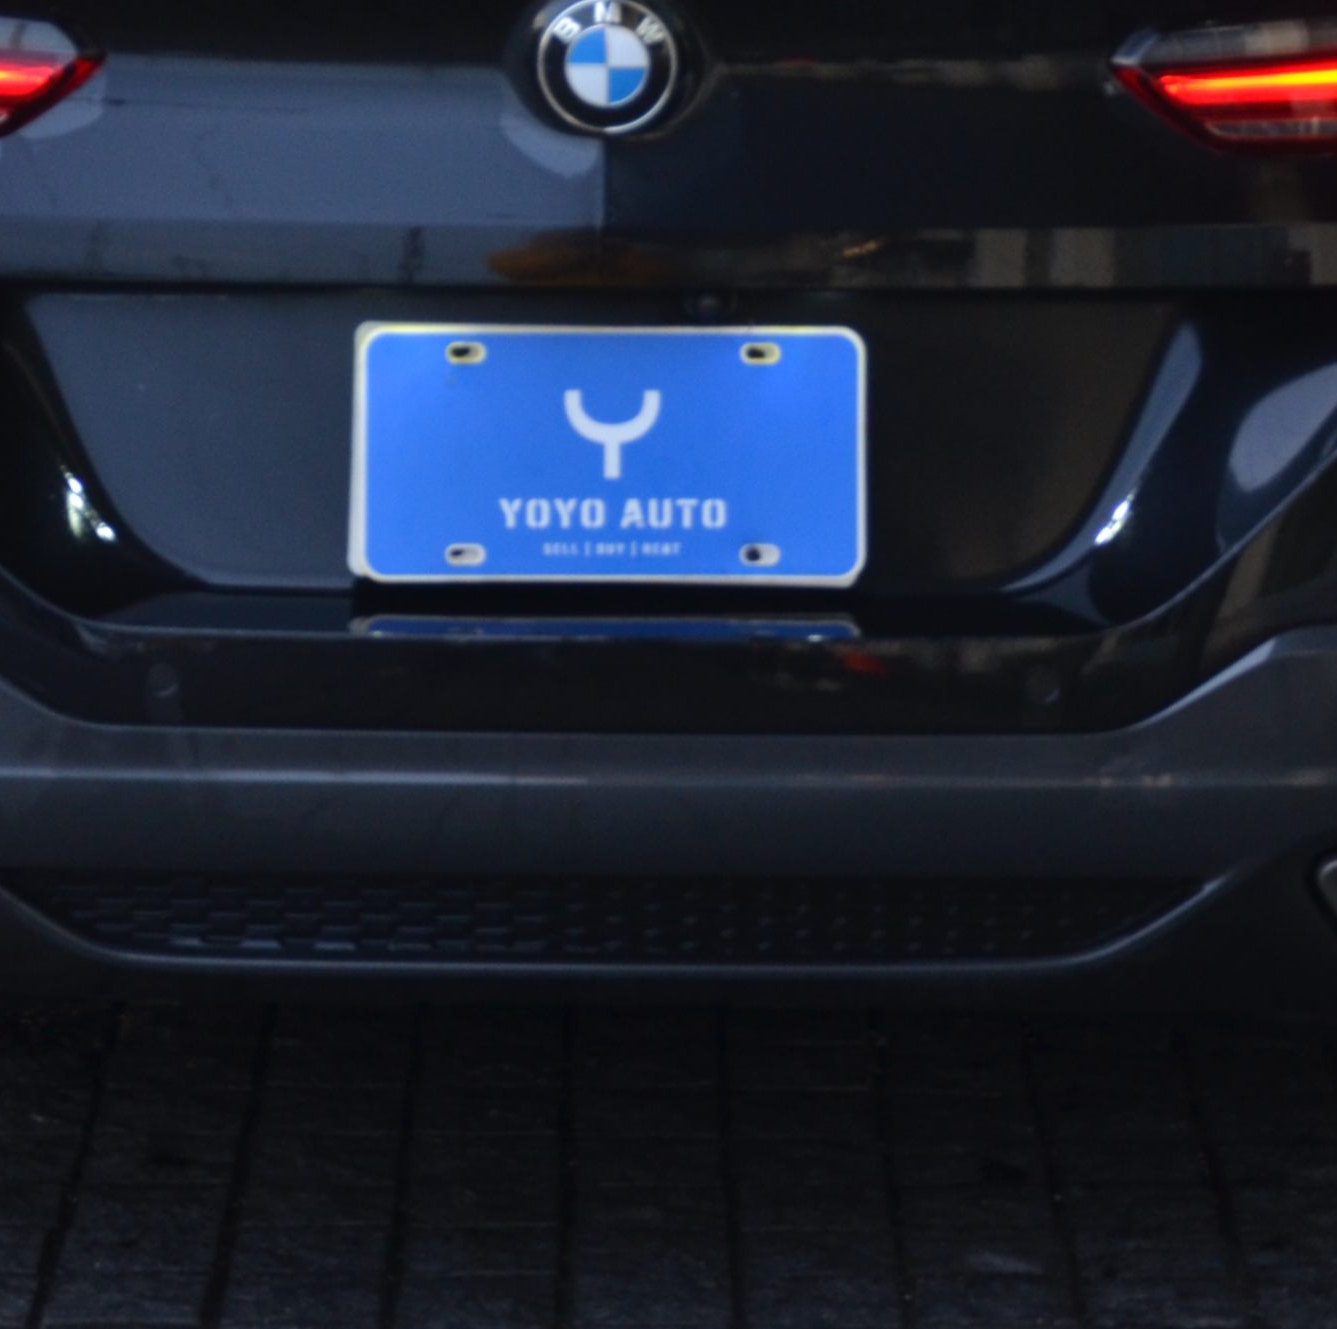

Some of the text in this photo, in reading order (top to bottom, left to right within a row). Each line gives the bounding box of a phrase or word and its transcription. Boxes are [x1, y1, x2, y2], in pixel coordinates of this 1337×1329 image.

[552, 0, 666, 46] BMW
[499, 498, 728, 529] YOYO AUTO
[543, 543, 579, 556] SELL
